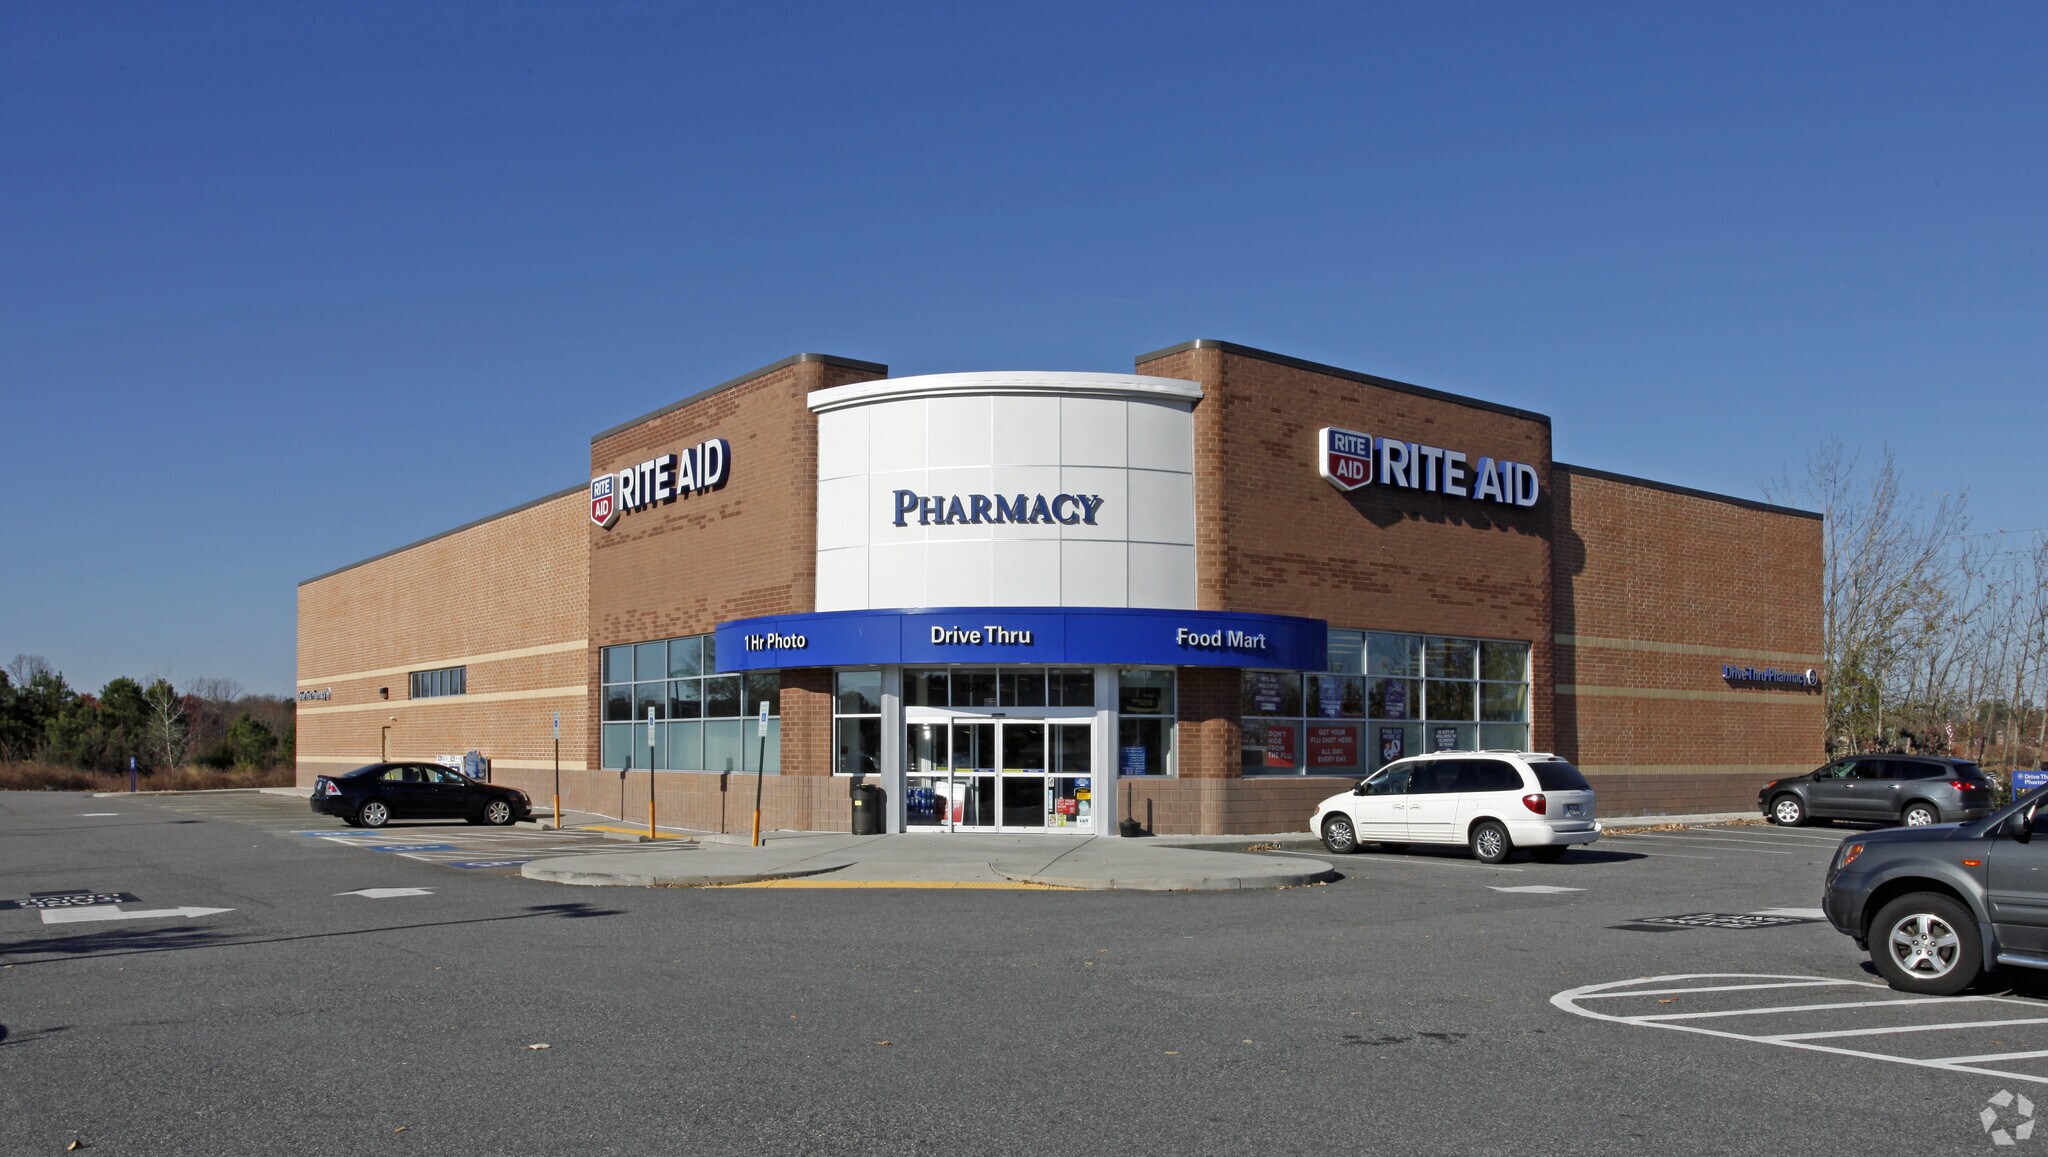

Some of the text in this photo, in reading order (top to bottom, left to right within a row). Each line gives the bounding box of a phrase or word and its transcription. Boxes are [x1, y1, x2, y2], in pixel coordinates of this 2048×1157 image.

[1334, 433, 1367, 455] RITE
[619, 438, 726, 511] RITE AID
[1336, 458, 1364, 480] AID
[1378, 437, 1540, 507] RITE AID
[593, 478, 611, 498] RITE
[594, 499, 609, 518] AID
[892, 489, 1104, 527] PHARMACY
[744, 632, 806, 651] 1 Hr Photo
[931, 625, 1031, 644] Drive Thru
[1177, 627, 1266, 649] Food Mart
[1724, 664, 1808, 687] Drive Thru Pharmacy
[1318, 728, 1329, 736] GET
